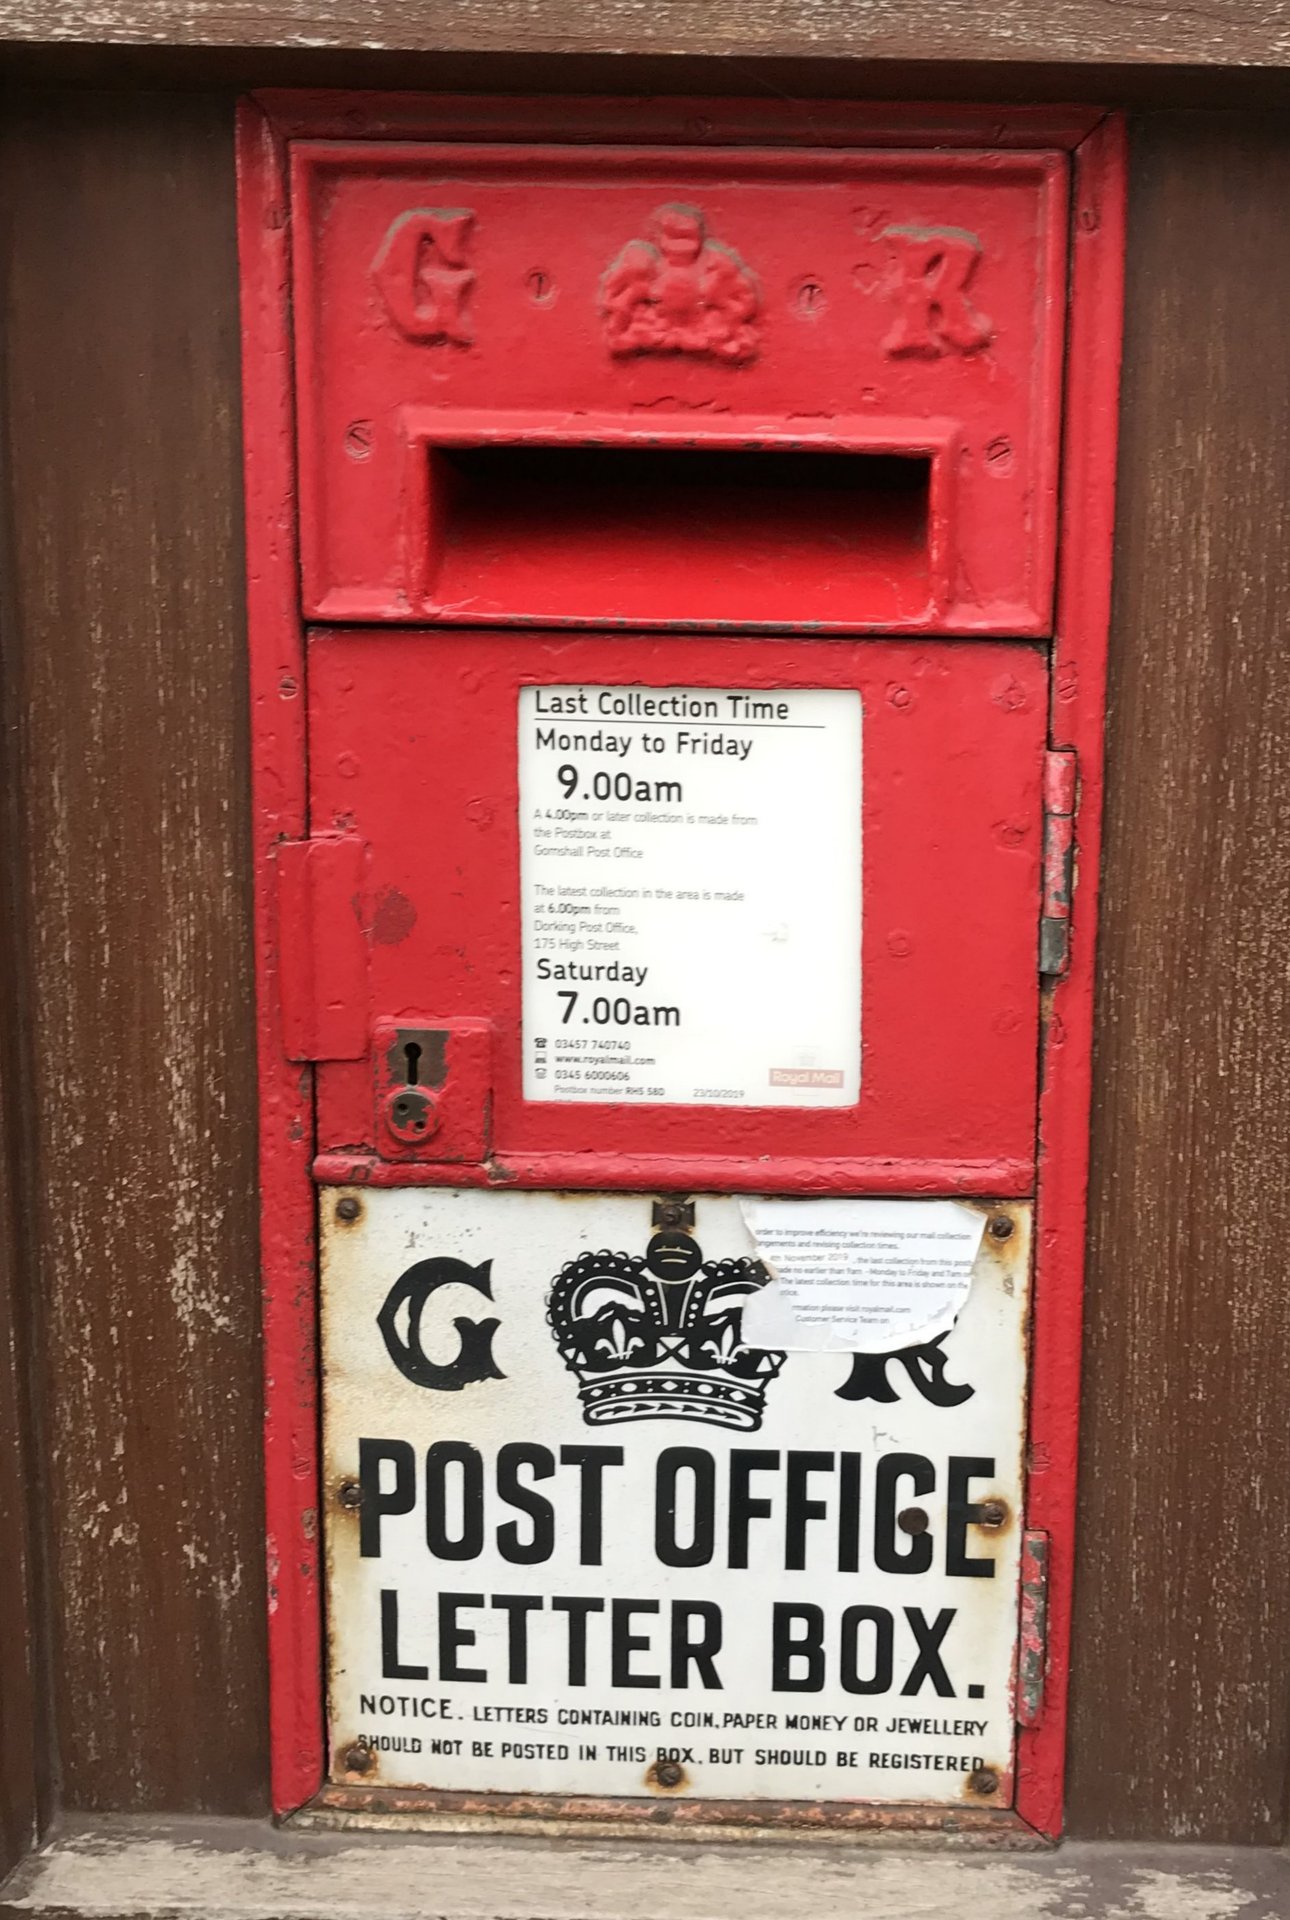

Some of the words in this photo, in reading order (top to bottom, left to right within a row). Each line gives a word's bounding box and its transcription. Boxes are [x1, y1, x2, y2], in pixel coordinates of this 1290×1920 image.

[536, 688, 588, 714] Last
[599, 692, 718, 717] Collection
[727, 695, 788, 719] Time
[536, 728, 632, 757] Monday
[642, 733, 666, 753] to
[677, 731, 753, 761] Friday
[557, 764, 682, 802] 9.00am
[545, 809, 589, 822] 4.00pm
[592, 812, 604, 821] or
[606, 810, 631, 822] later
[633, 811, 683, 824] collection
[686, 812, 695, 824] is
[698, 813, 729, 825] made
[731, 813, 758, 825] from
[533, 827, 552, 838] the
[554, 827, 598, 839] Postbox
[600, 830, 612, 839] at
[587, 846, 611, 858] Post
[613, 847, 644, 859] Office
[533, 884, 555, 896] The
[557, 885, 587, 897] latest
[589, 886, 639, 899] collection
[642, 888, 653, 899] in
[655, 888, 673, 900] the
[675, 890, 700, 900] area
[702, 889, 712, 900] is
[714, 890, 745, 901] made
[533, 904, 545, 914] at
[547, 903, 592, 917] 6.00pm
[593, 903, 621, 916] from
[533, 919, 576, 934] Dorking
[578, 921, 603, 933] Post
[533, 938, 556, 950] 175
[558, 938, 584, 952] High
[587, 939, 620, 951] Street
[536, 957, 648, 987] Saturday
[557, 990, 680, 1027] 7.00am
[554, 1039, 588, 1050] 03457
[591, 1040, 631, 1051] 740740
[554, 1055, 656, 1066] www.royalmail.com
[554, 1069, 581, 1080] 0345
[584, 1070, 630, 1081] 6000606
[773, 1070, 809, 1086] Royal
[812, 1071, 841, 1085] Mail
[554, 1084, 587, 1094] Postbox
[590, 1086, 623, 1095] number
[376, 1257, 507, 1392] G
[358, 1437, 624, 1566] POST
[654, 1445, 996, 1578] OFFICE
[380, 1589, 724, 1690] LETTER
[771, 1602, 985, 1699] BOX.
[359, 1694, 464, 1720] NOTICE.
[473, 1705, 548, 1724] LETTERS
[558, 1709, 661, 1728] CONTAINING
[785, 1714, 848, 1732] MONEY
[854, 1716, 878, 1733] OR
[886, 1717, 988, 1737] JEWELLERY
[357, 1733, 422, 1754] SHOULD
[431, 1738, 463, 1756] NOT
[472, 1741, 494, 1758] BE
[501, 1742, 569, 1761] POSTED
[579, 1745, 597, 1762] IN
[606, 1746, 647, 1763] THIS
[709, 1748, 744, 1765] BUT
[755, 1749, 827, 1767] SHOULD
[836, 1751, 859, 1768] BE
[869, 1752, 984, 1773] REGISTERED
